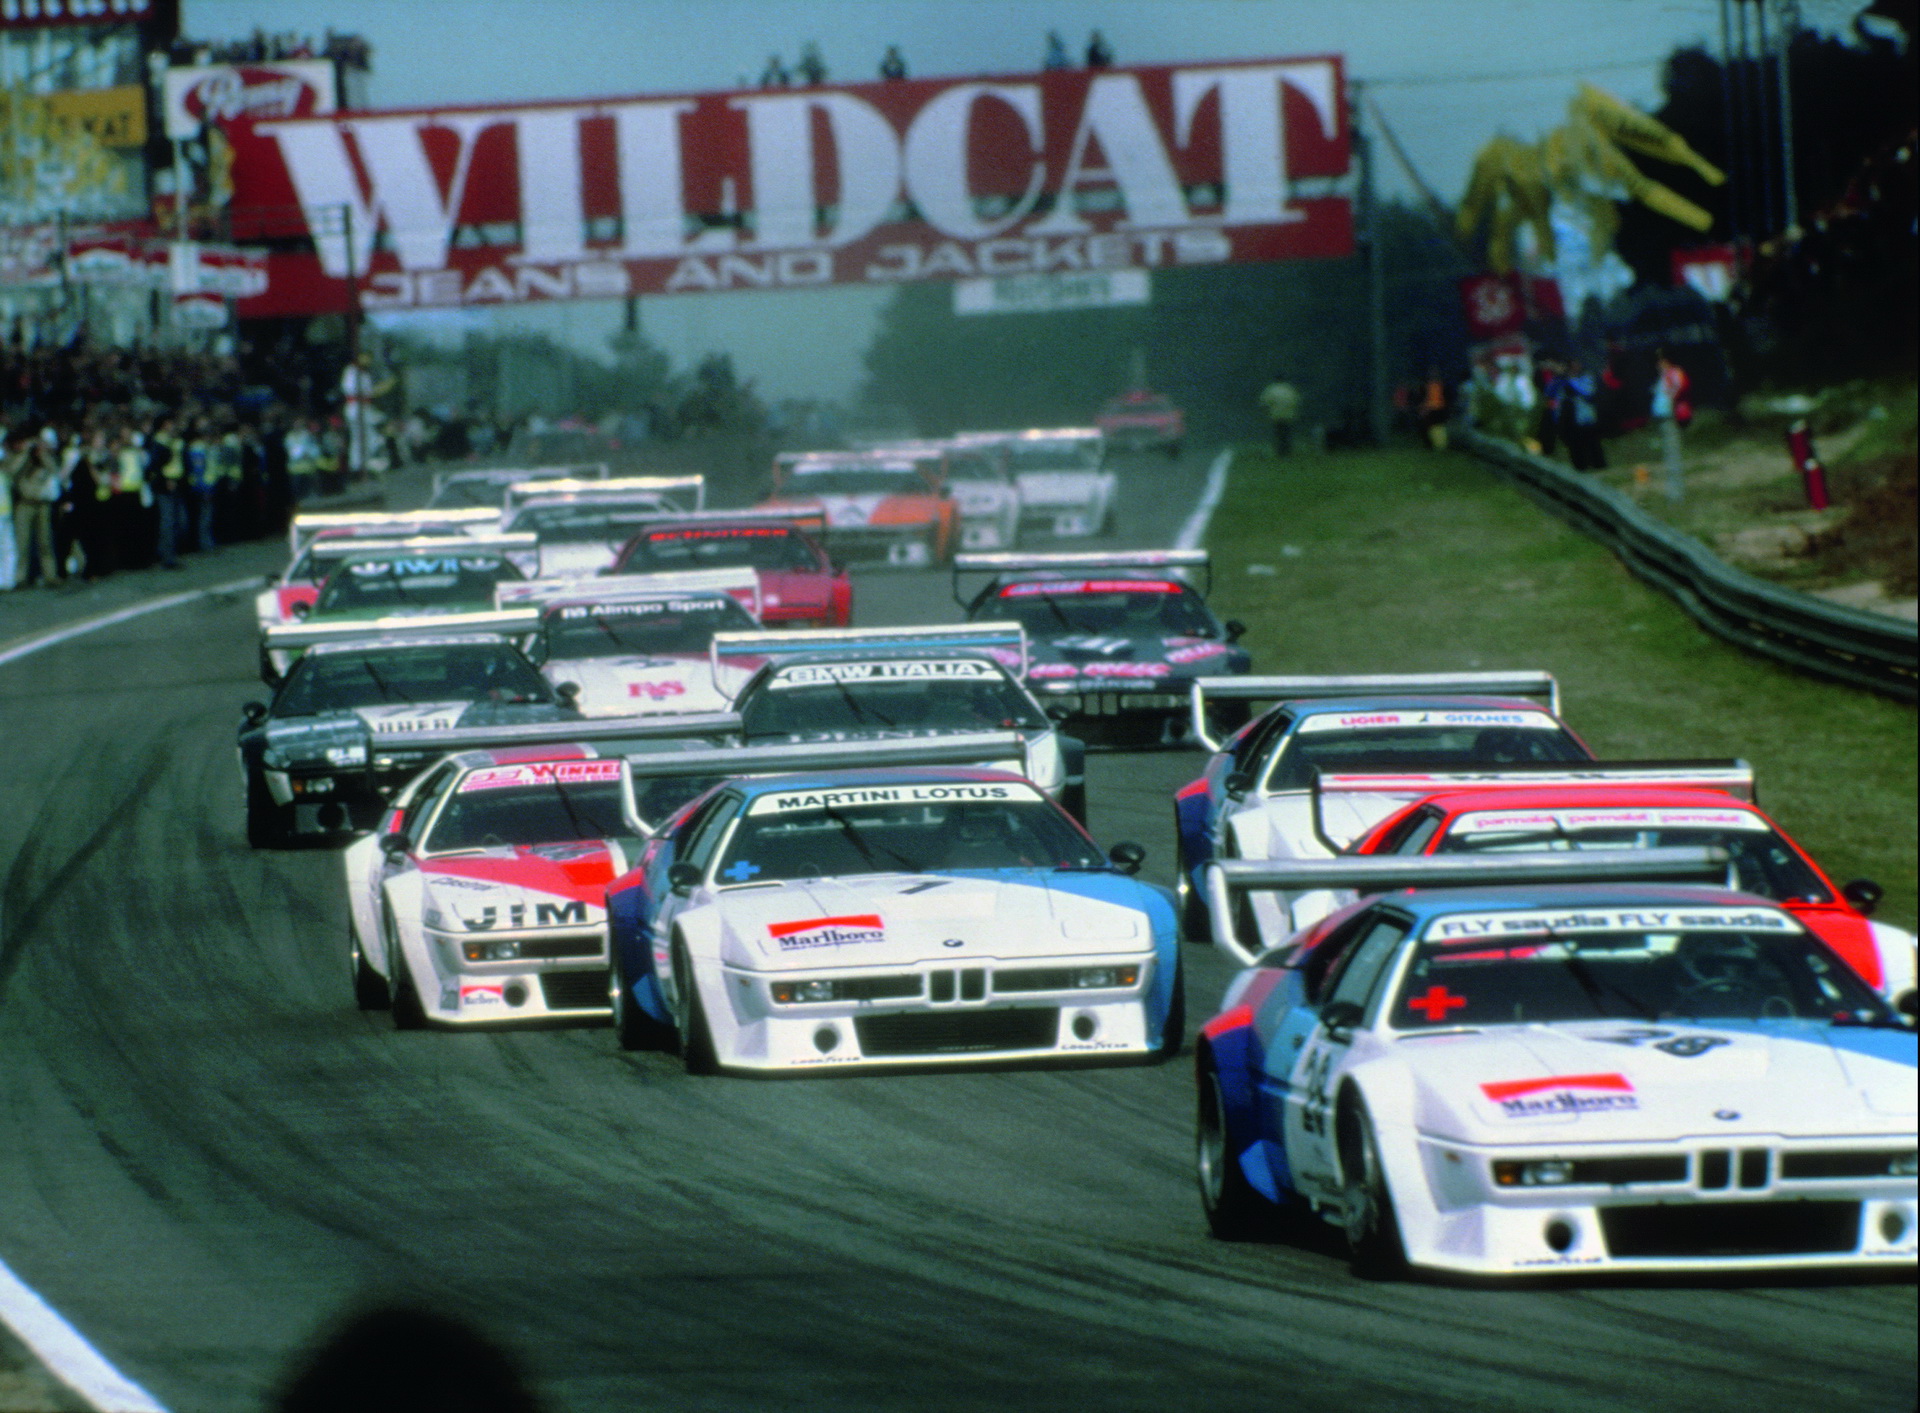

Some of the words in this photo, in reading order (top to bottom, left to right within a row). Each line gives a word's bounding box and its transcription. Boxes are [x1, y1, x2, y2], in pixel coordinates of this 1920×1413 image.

[254, 60, 1337, 278] WILDCAT
[360, 264, 631, 308] JEANS
[663, 250, 834, 293] AND
[865, 230, 1232, 278] JACKETS
[591, 603, 664, 617] Alimpo
[667, 600, 726, 612] Sport
[789, 665, 871, 684] BMW
[882, 662, 980, 679] ITALIA
[1341, 714, 1401, 727] LIGIER
[1444, 713, 1526, 726] GITANES
[530, 764, 620, 777] WINNE
[778, 790, 901, 810] MARTINI
[912, 786, 1010, 803] LOTUS
[1566, 812, 1650, 826] parmalat
[1660, 811, 1742, 825] parmalat
[463, 900, 588, 931] JIM
[1440, 919, 1496, 937] FLY
[1502, 915, 1610, 933] saudia
[1617, 912, 1671, 930] FLY
[1678, 911, 1784, 929] saudia
[778, 929, 884, 949] Marlboro
[1501, 1090, 1639, 1113] Marlboro
